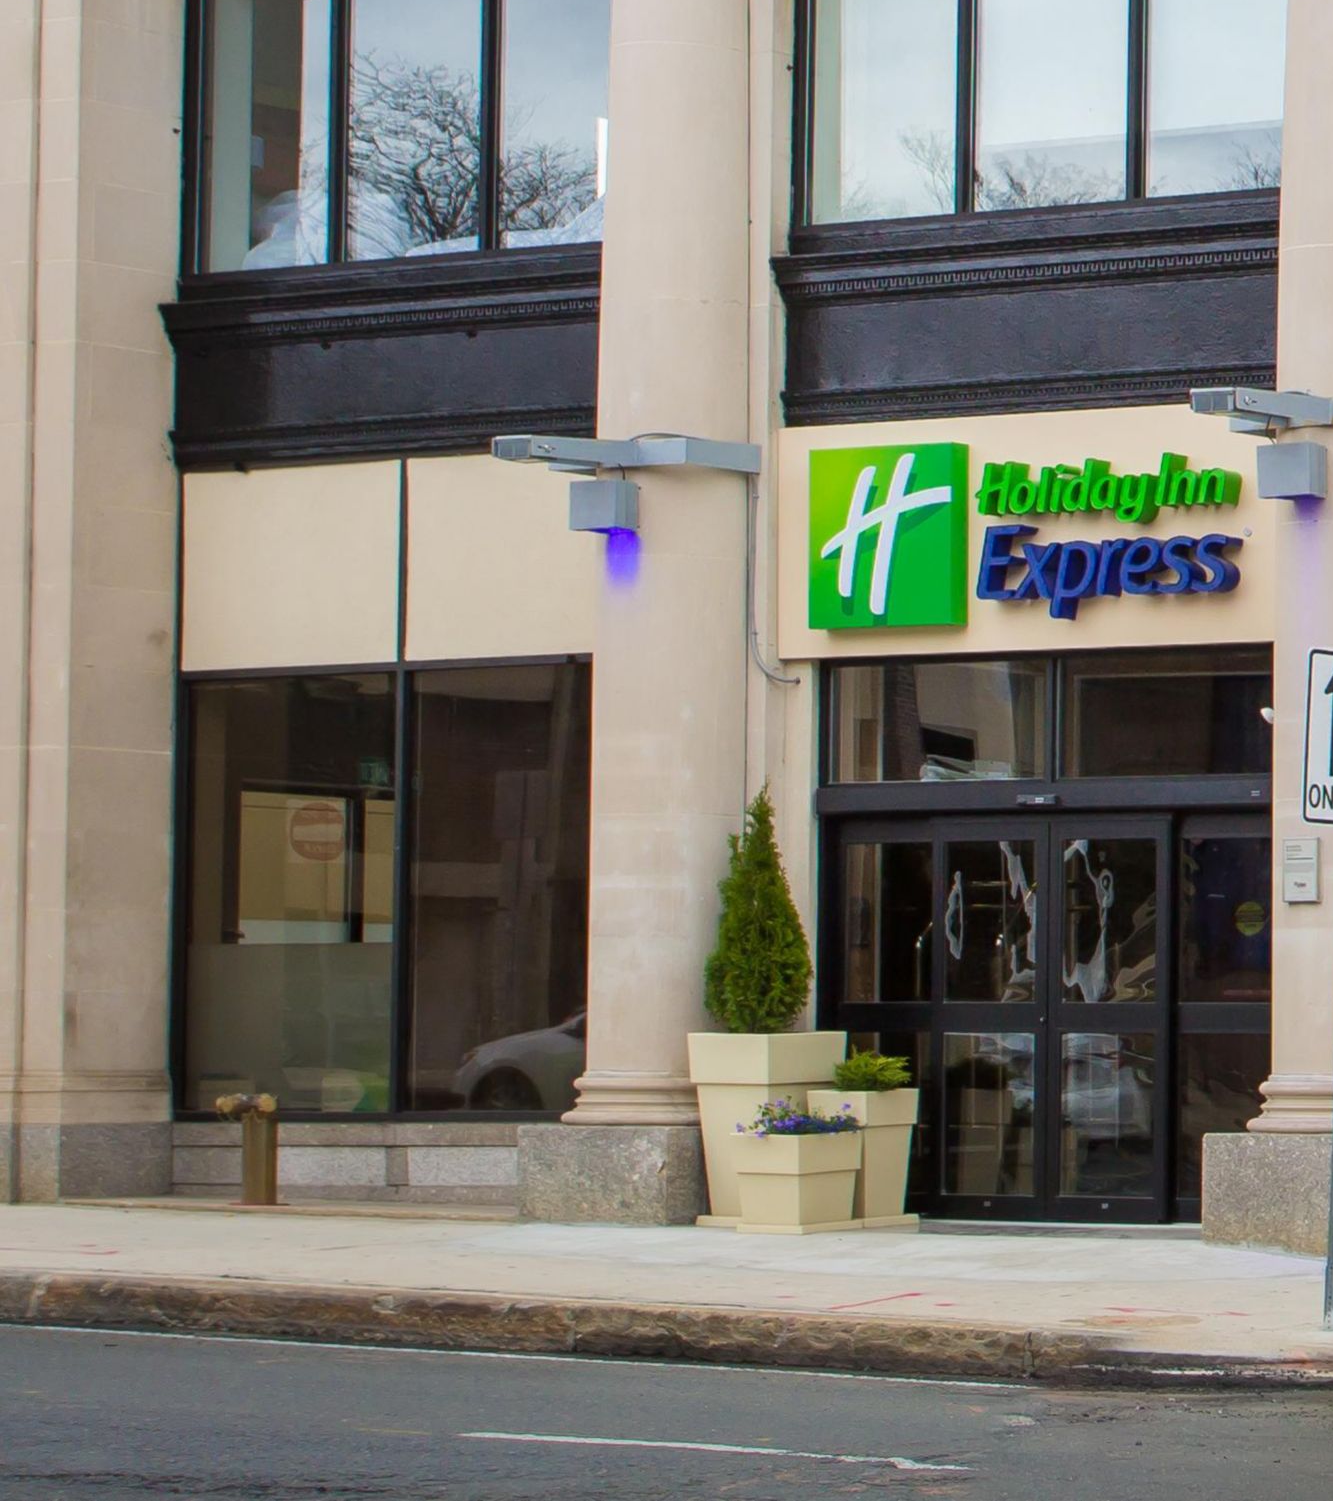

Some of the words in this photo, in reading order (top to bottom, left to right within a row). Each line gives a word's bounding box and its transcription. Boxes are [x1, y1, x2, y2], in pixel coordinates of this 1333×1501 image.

[976, 457, 1158, 523] Holiday
[1154, 452, 1242, 508] Inn
[976, 524, 1243, 620] Express
